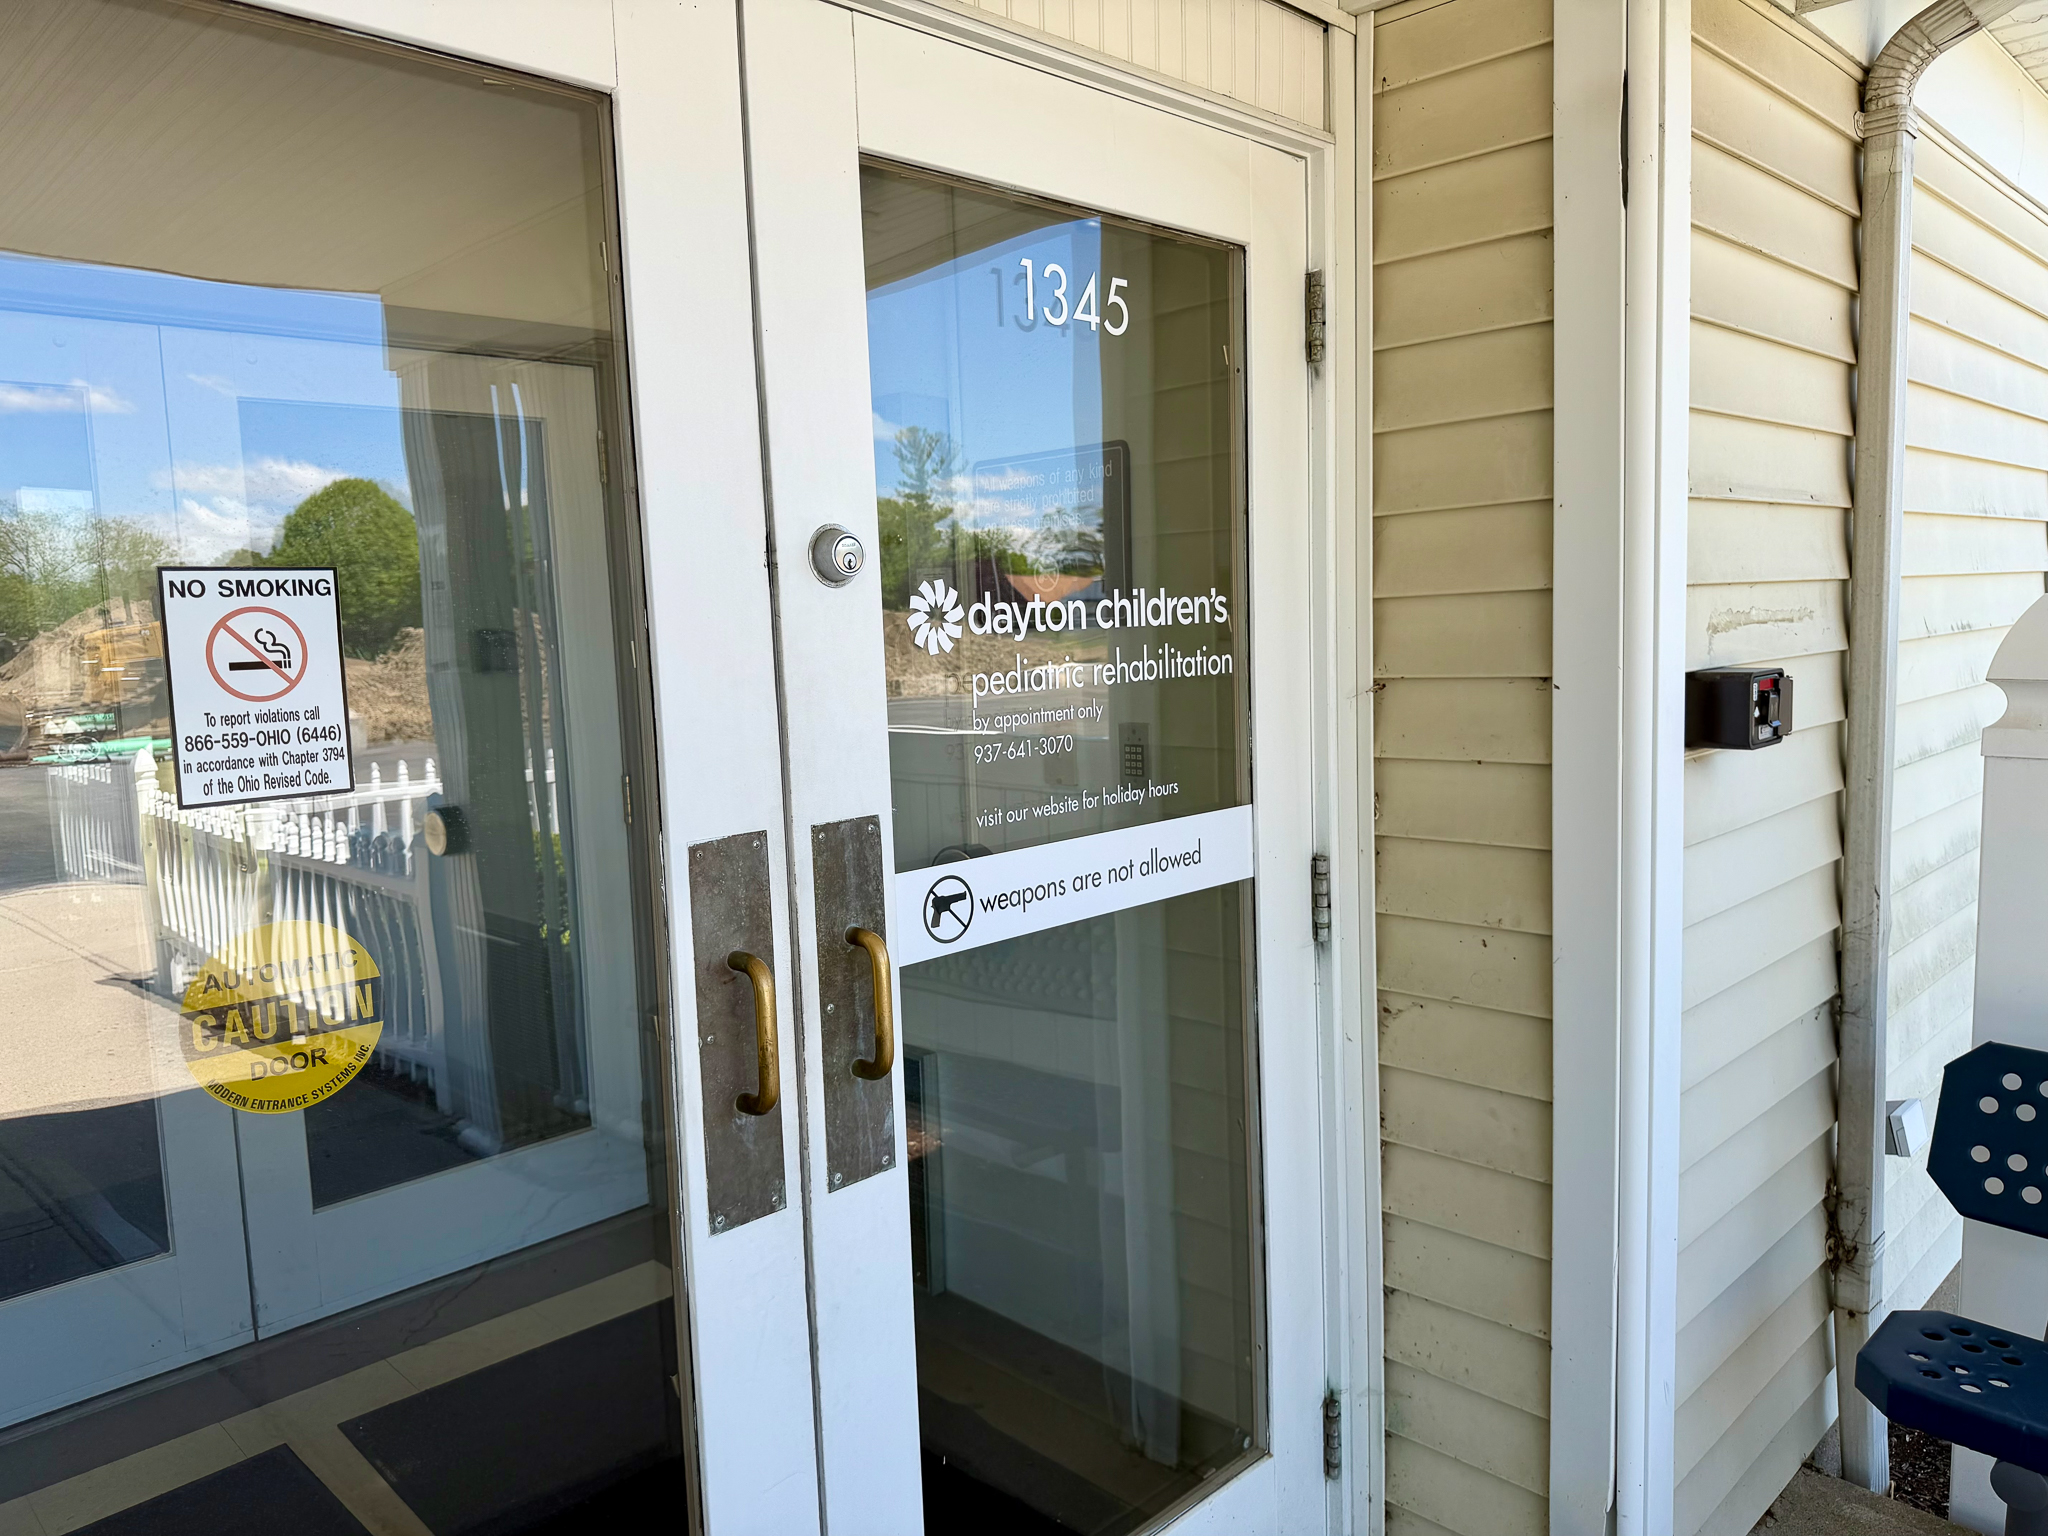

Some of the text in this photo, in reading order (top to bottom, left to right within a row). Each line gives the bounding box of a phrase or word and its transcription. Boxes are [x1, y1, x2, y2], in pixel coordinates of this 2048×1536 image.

[1019, 258, 1129, 336] 1345
[1000, 474, 1045, 491] weapons
[1050, 468, 1060, 484] of
[1065, 467, 1084, 484] any
[1089, 460, 1112, 479] kind
[984, 485, 1094, 514] are strictly prohibited
[169, 579, 331, 598] NO SMOKING
[968, 591, 1086, 641] dayton
[971, 643, 1233, 708] pediatric rehabilitation
[204, 706, 320, 728] To report violations call
[973, 698, 1103, 735] by appointment only
[185, 724, 342, 752] 866-559-OHIO (6446)
[974, 734, 1074, 764] 937-641-3070
[183, 747, 345, 774] in accordance with Chapter 3794
[203, 769, 332, 796] of the Ohio Revised Code.
[976, 780, 1179, 828] visit our website for holiday hours
[979, 838, 1202, 913] weapons are not allowed
[203, 950, 358, 994] AUTOMATIC
[192, 983, 374, 1052] CAUTION
[206, 1043, 371, 1111] MODERN ENTRANCE SYSTEMS INC.
[250, 1048, 329, 1081] DOOR
